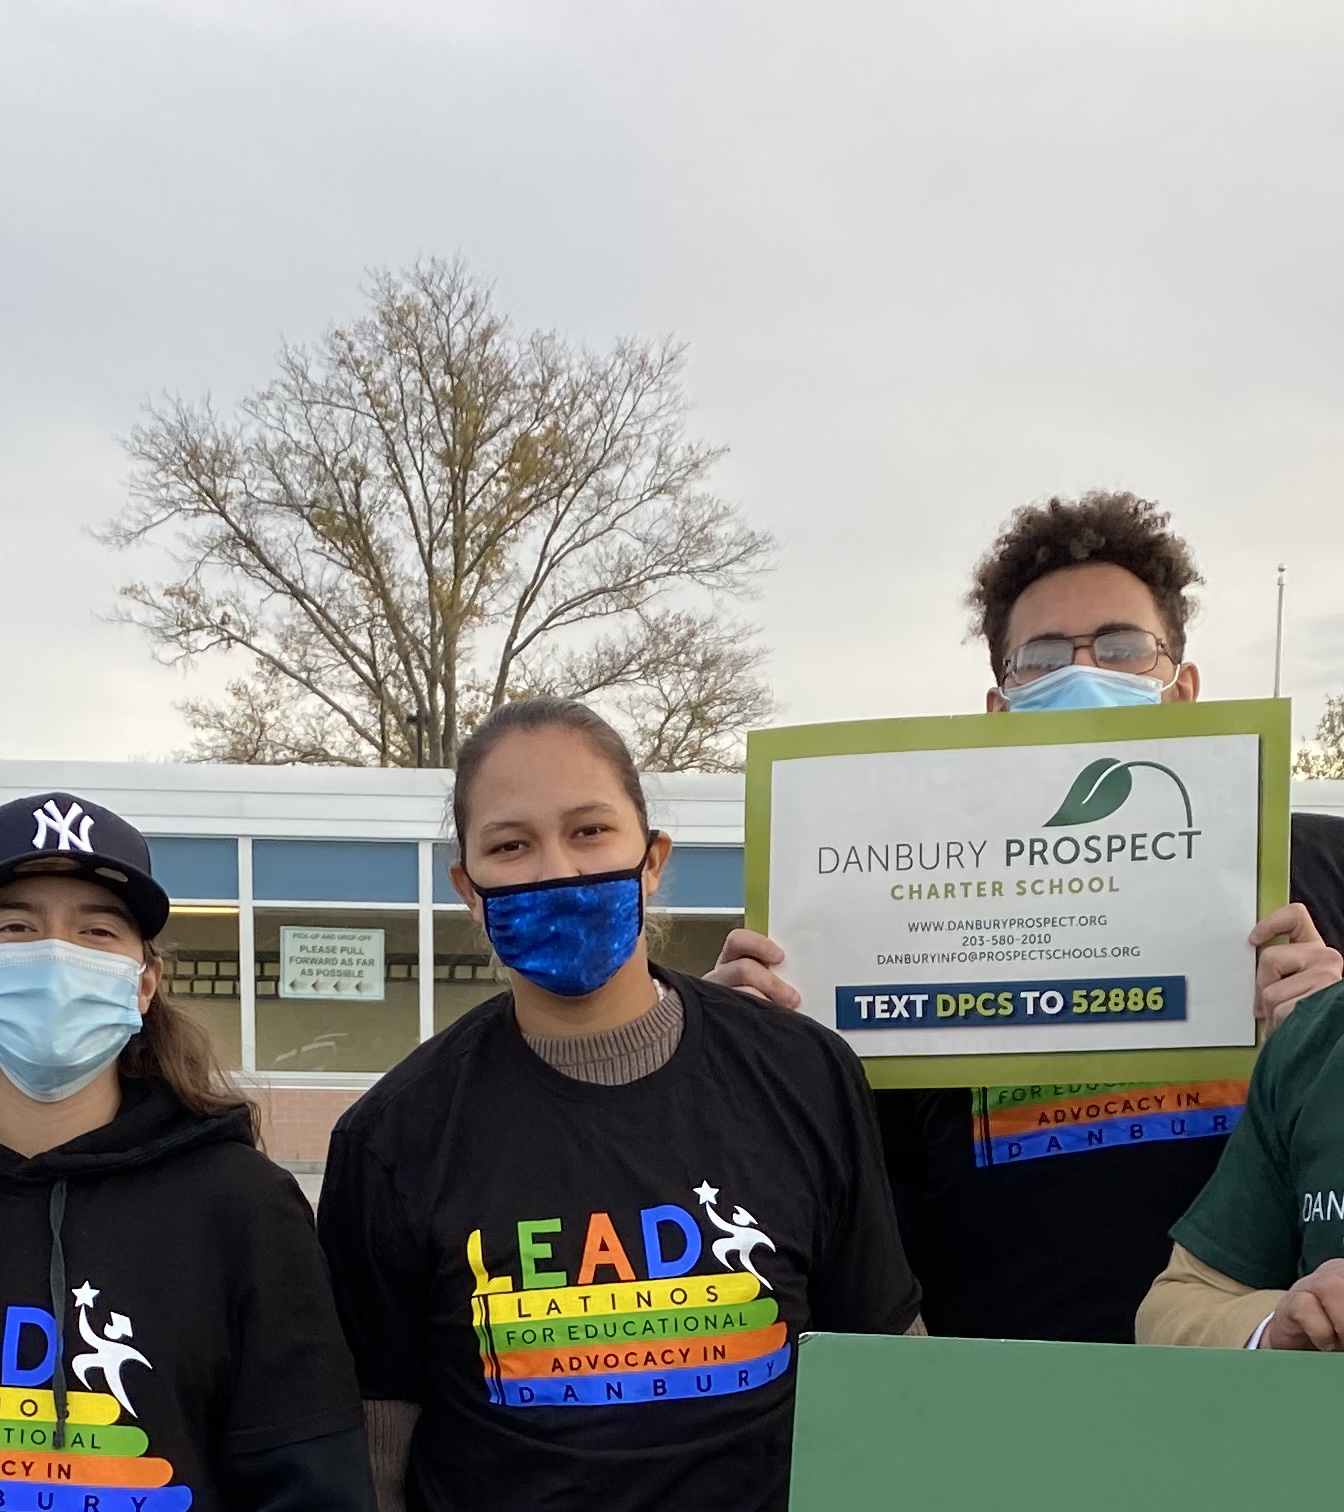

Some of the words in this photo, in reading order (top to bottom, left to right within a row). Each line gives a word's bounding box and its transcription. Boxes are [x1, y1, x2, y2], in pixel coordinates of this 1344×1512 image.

[32, 799, 95, 853] NY
[818, 840, 988, 875] DANBURY
[1006, 831, 1201, 866] PROSPECT
[891, 880, 1005, 900] CHARTER
[1016, 876, 1120, 897] SCHOOL
[908, 914, 1108, 934] WWW.DANBURYPROSPECT.ORG
[299, 945, 337, 954] PLEASE
[340, 946, 365, 955] PULL
[876, 946, 1141, 966] DANBURYINFO@PROSPECTSCHOOLS.ORG
[962, 933, 1052, 948] 203-580-2010
[289, 956, 338, 965] FORWARD
[340, 957, 354, 966] AS
[356, 958, 375, 967] FAR
[299, 968, 314, 977] AS
[316, 969, 365, 978] POSSIBLE
[855, 993, 930, 1020] TEXT
[936, 991, 1014, 1018] DPCS
[1020, 990, 1064, 1015] TO
[1071, 987, 1165, 1013] 52886
[1038, 1095, 1166, 1127] ADVOCACY
[1177, 1091, 1200, 1107] IN
[1007, 1115, 1228, 1159] DANBUR
[466, 1204, 702, 1296] LEAD
[517, 1285, 720, 1318] LATINOS
[506, 1327, 555, 1345] FOR
[568, 1311, 748, 1341] EDUCATIONAL
[551, 1347, 692, 1373] ADVOCACY
[703, 1344, 726, 1362] IN
[519, 1360, 774, 1404] DANBURY
[47, 1463, 71, 1480] IN
